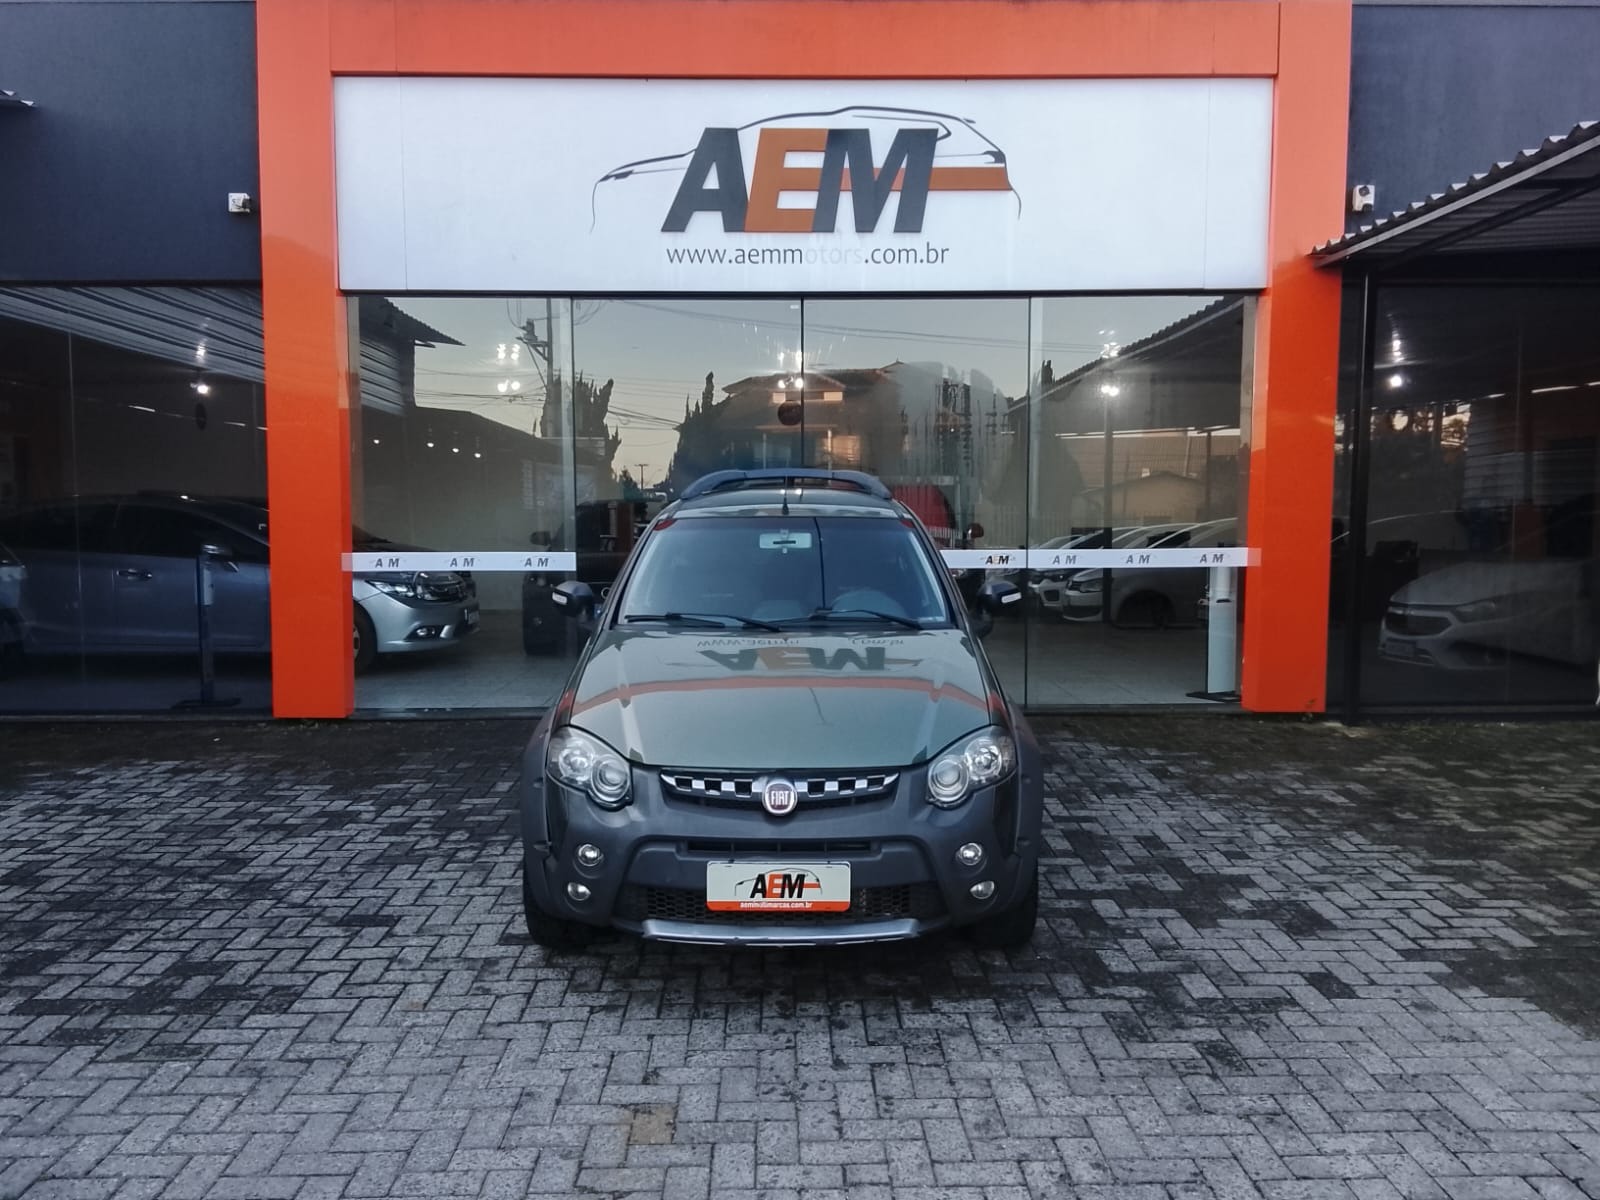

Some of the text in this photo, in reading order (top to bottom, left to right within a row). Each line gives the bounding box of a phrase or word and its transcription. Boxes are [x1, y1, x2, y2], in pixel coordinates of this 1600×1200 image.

[660, 127, 939, 233] AEM
[770, 790, 790, 806] FIAT
[749, 873, 806, 899] AEM
